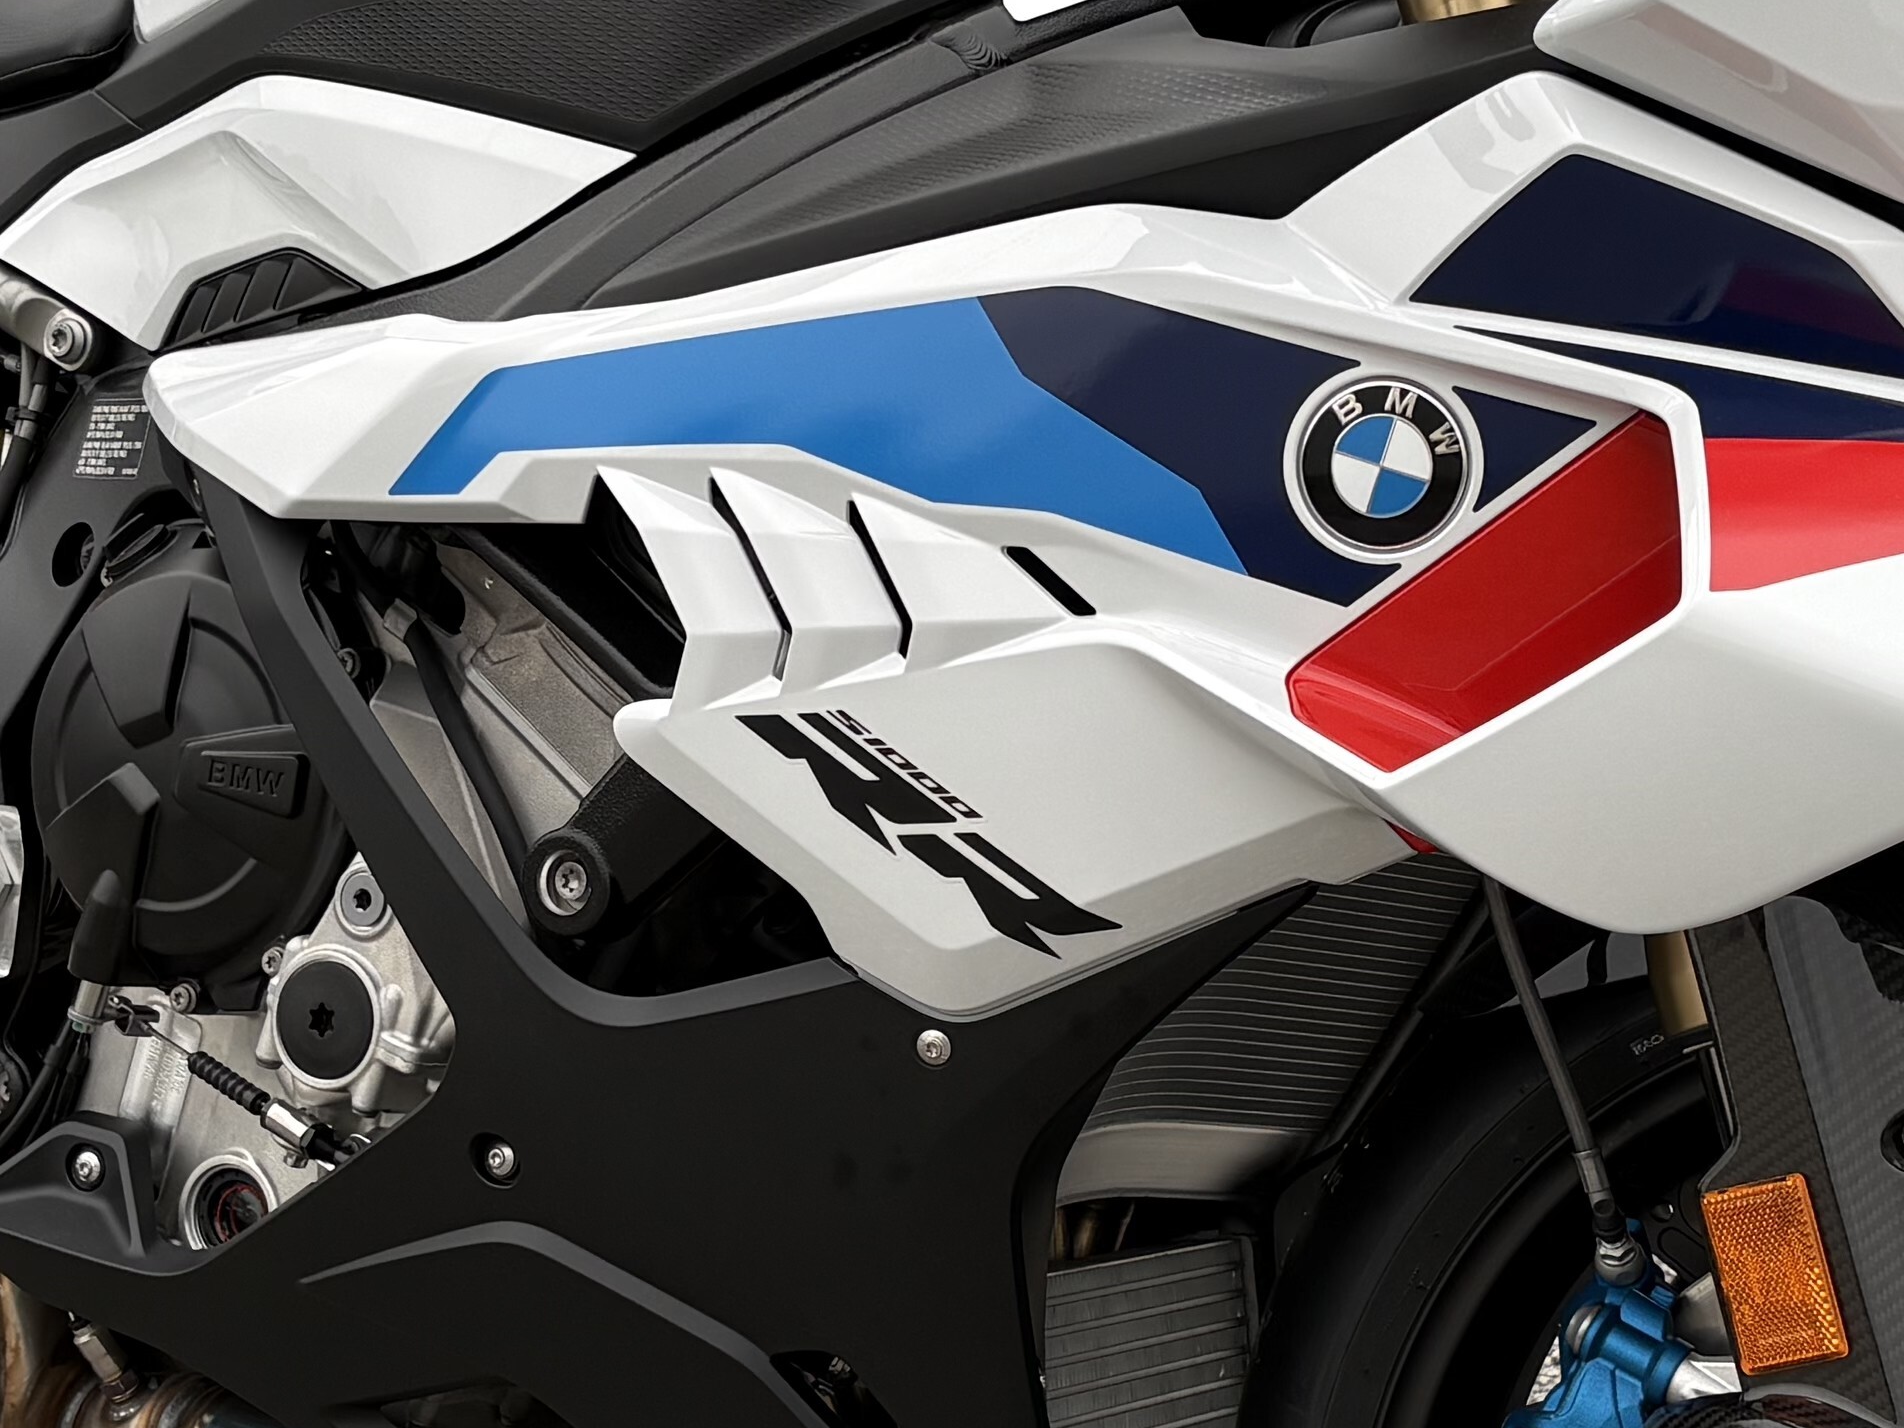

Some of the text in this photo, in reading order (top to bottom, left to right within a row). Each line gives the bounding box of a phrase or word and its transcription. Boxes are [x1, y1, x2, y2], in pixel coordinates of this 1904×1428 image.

[1332, 386, 1462, 457] BMW
[204, 756, 286, 798] BMW
[827, 708, 985, 821] S1000
[735, 712, 1123, 960] RR
